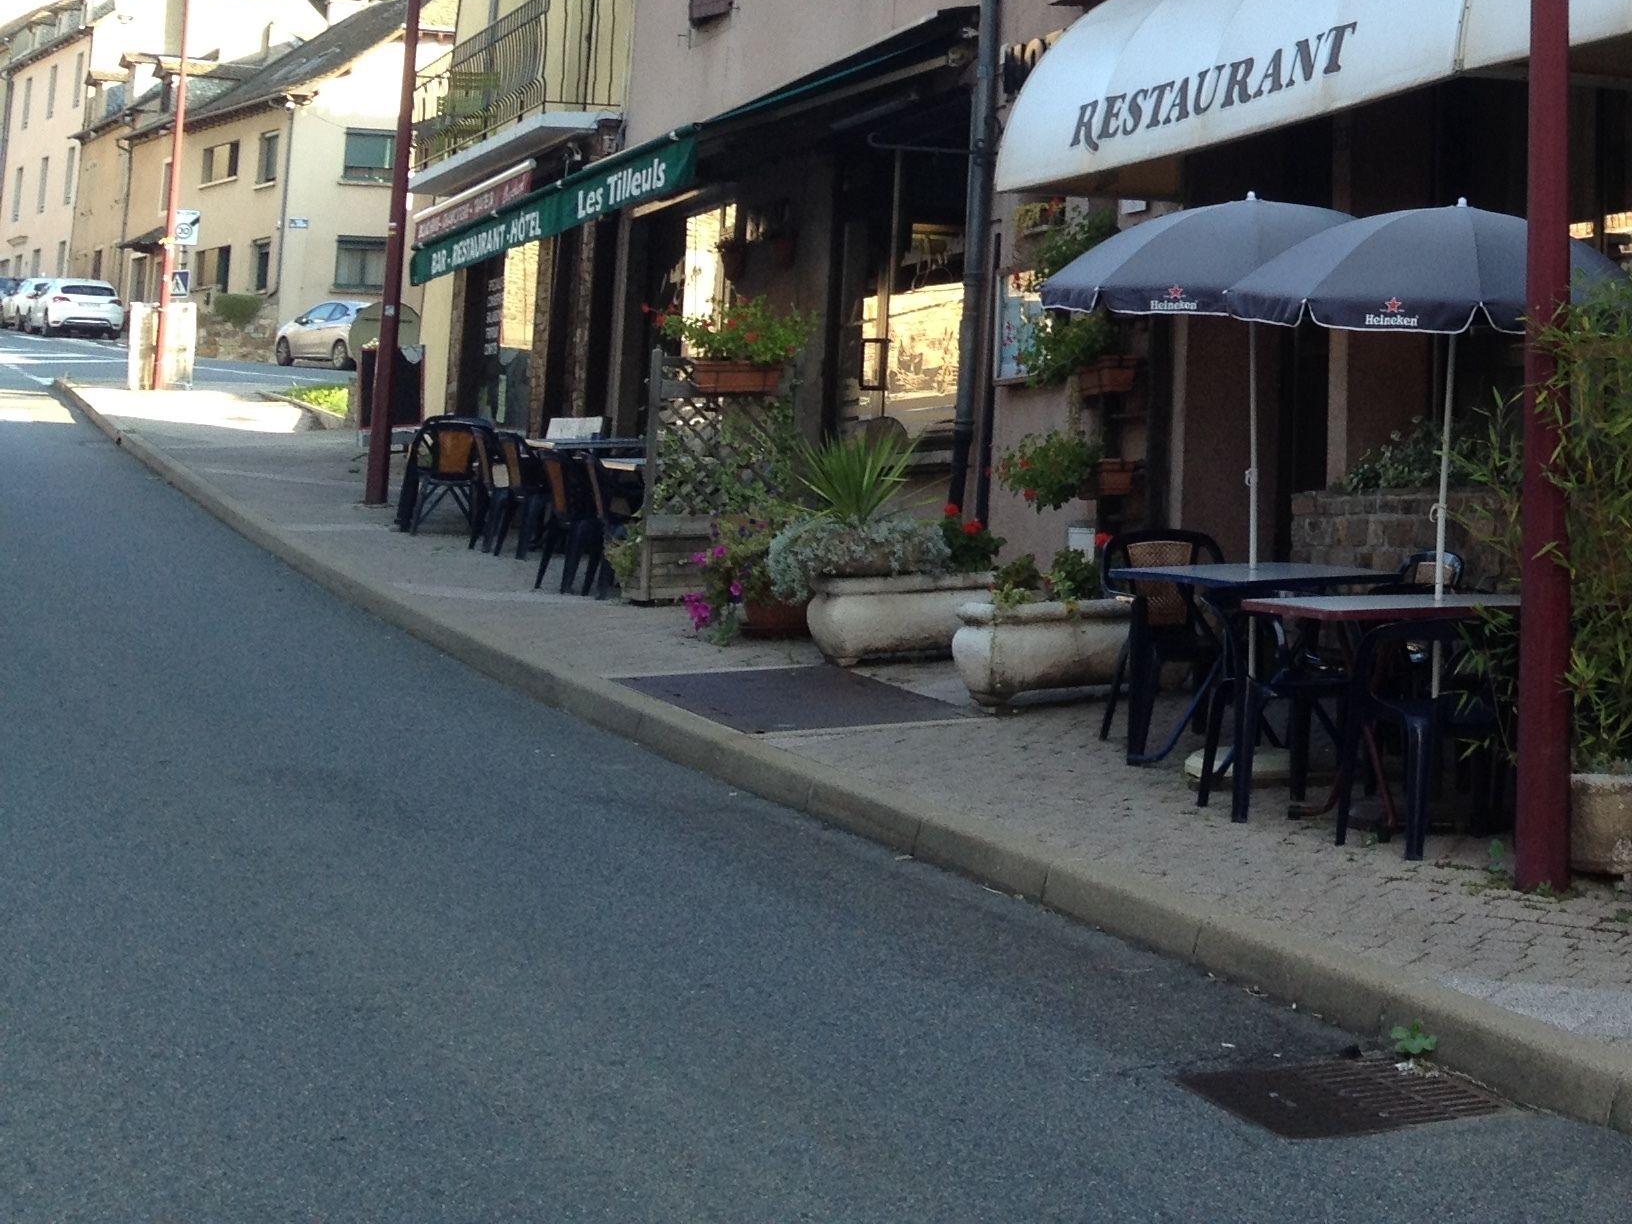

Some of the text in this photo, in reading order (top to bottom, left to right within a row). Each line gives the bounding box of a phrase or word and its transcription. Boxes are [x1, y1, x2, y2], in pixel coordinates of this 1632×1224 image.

[1069, 20, 1358, 152] RESTAURANT
[577, 187, 604, 219] Les
[606, 158, 667, 205] Tilleuls
[431, 248, 447, 275] BAR
[451, 223, 506, 267] RESTAURANT
[1150, 299, 1198, 310] Heineken
[1364, 313, 1419, 327] Heineken
